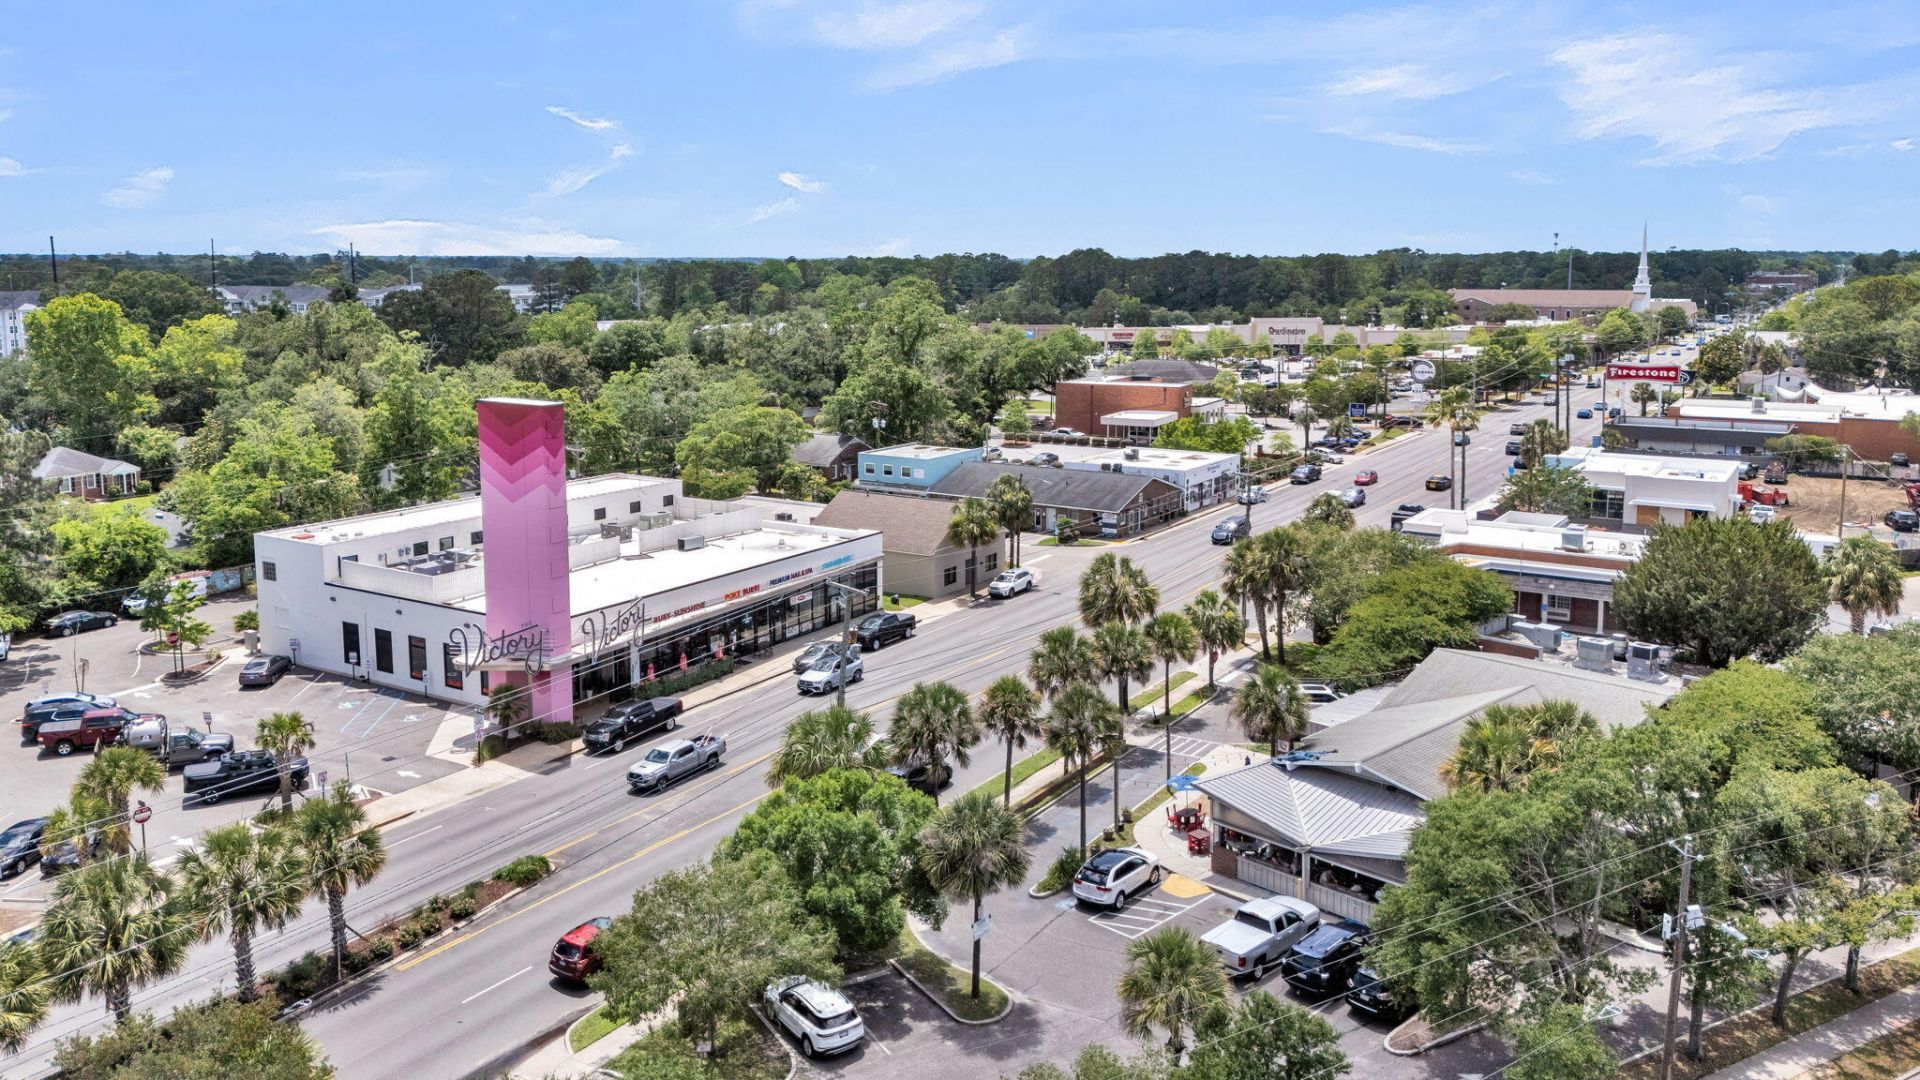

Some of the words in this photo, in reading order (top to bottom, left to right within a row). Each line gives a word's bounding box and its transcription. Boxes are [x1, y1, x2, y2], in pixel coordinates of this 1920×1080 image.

[1608, 367, 1677, 378] Firestone
[725, 590, 741, 600] POKE
[653, 612, 671, 624] RUBY
[673, 601, 706, 617] SUNSHINE
[582, 597, 654, 664] Victory
[449, 623, 554, 678] Victory
